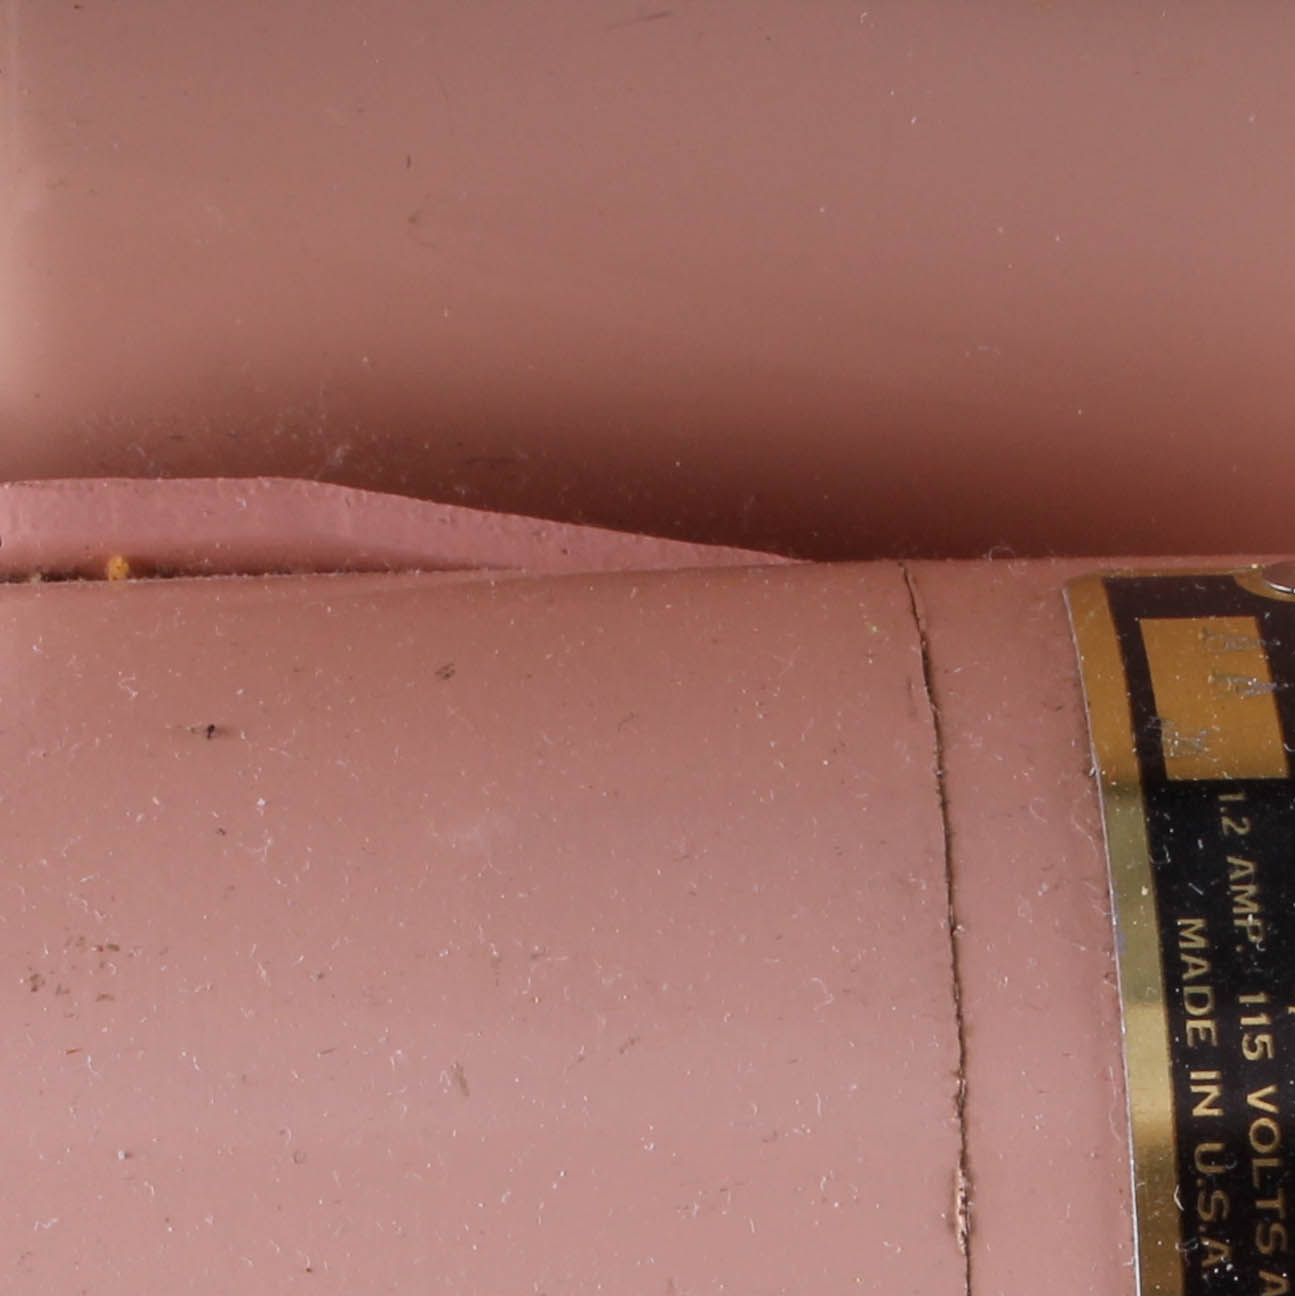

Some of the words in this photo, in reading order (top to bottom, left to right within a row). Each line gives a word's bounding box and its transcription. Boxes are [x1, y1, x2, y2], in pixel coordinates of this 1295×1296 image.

[1215, 791, 1251, 838] 1.2
[1223, 855, 1265, 954] AMP.
[1176, 917, 1226, 1050] MADE
[1235, 991, 1276, 1062] 115
[1189, 1069, 1221, 1118] IN
[1244, 1084, 1289, 1254] VOLTS
